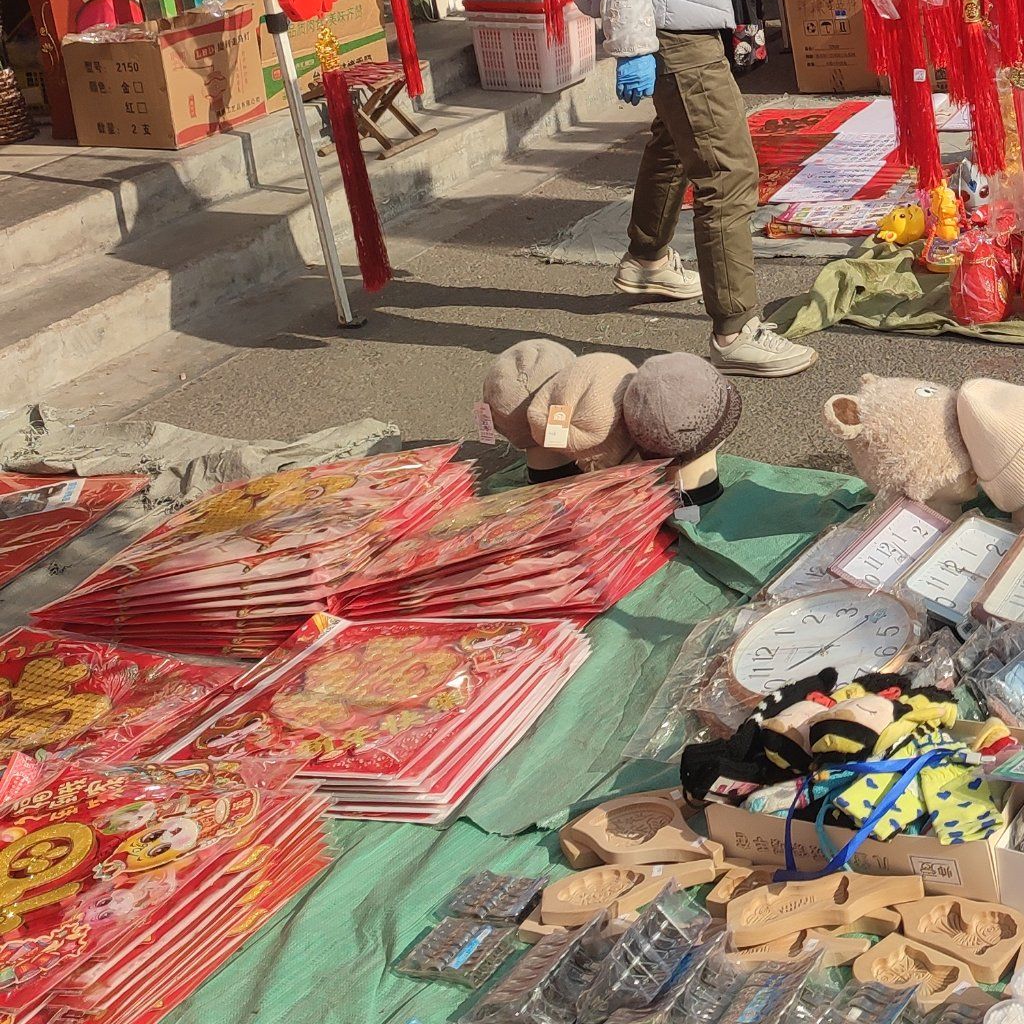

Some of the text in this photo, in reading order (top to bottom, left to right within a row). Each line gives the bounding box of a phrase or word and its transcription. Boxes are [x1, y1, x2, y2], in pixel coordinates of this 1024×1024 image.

[116, 62, 139, 73] 2150
[125, 102, 135, 114] 红
[131, 125, 138, 135] 2
[864, 555, 883, 571] 11
[876, 541, 897, 559] 12
[892, 532, 908, 545] 1
[911, 525, 930, 539] 2
[926, 575, 950, 592] 11
[941, 559, 965, 577] 12
[960, 546, 978, 557] 1
[986, 542, 1007, 557] 2
[835, 605, 859, 619] 3
[801, 613, 827, 626] 2
[774, 627, 796, 636] 1
[875, 625, 901, 638] 5
[751, 645, 780, 662] 12
[873, 645, 899, 658] 6
[748, 666, 771, 679] 11
